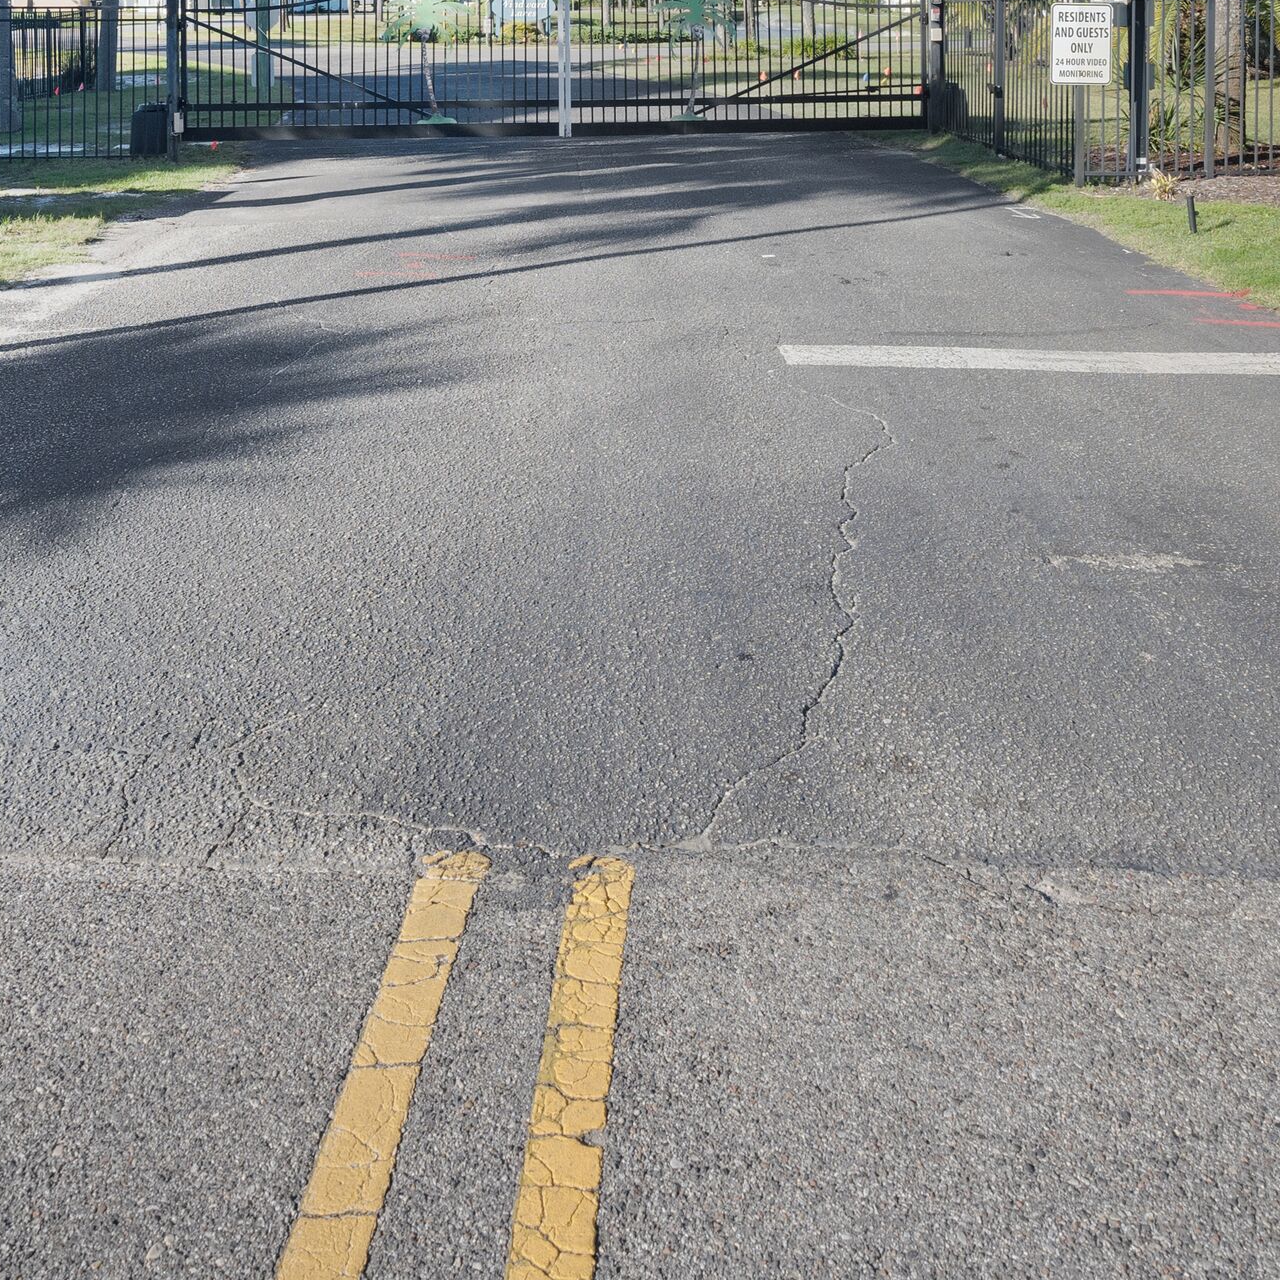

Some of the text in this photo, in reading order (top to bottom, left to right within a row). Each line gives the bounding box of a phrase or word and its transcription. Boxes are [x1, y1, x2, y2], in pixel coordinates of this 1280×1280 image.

[1058, 11, 1106, 22] RESIDENTS
[1055, 27, 1109, 38] AND GUESTS
[1070, 42, 1093, 53] ONLY
[1055, 58, 1107, 66] 24 HOUR VIDEO
[1059, 70, 1103, 78] MONITORING
